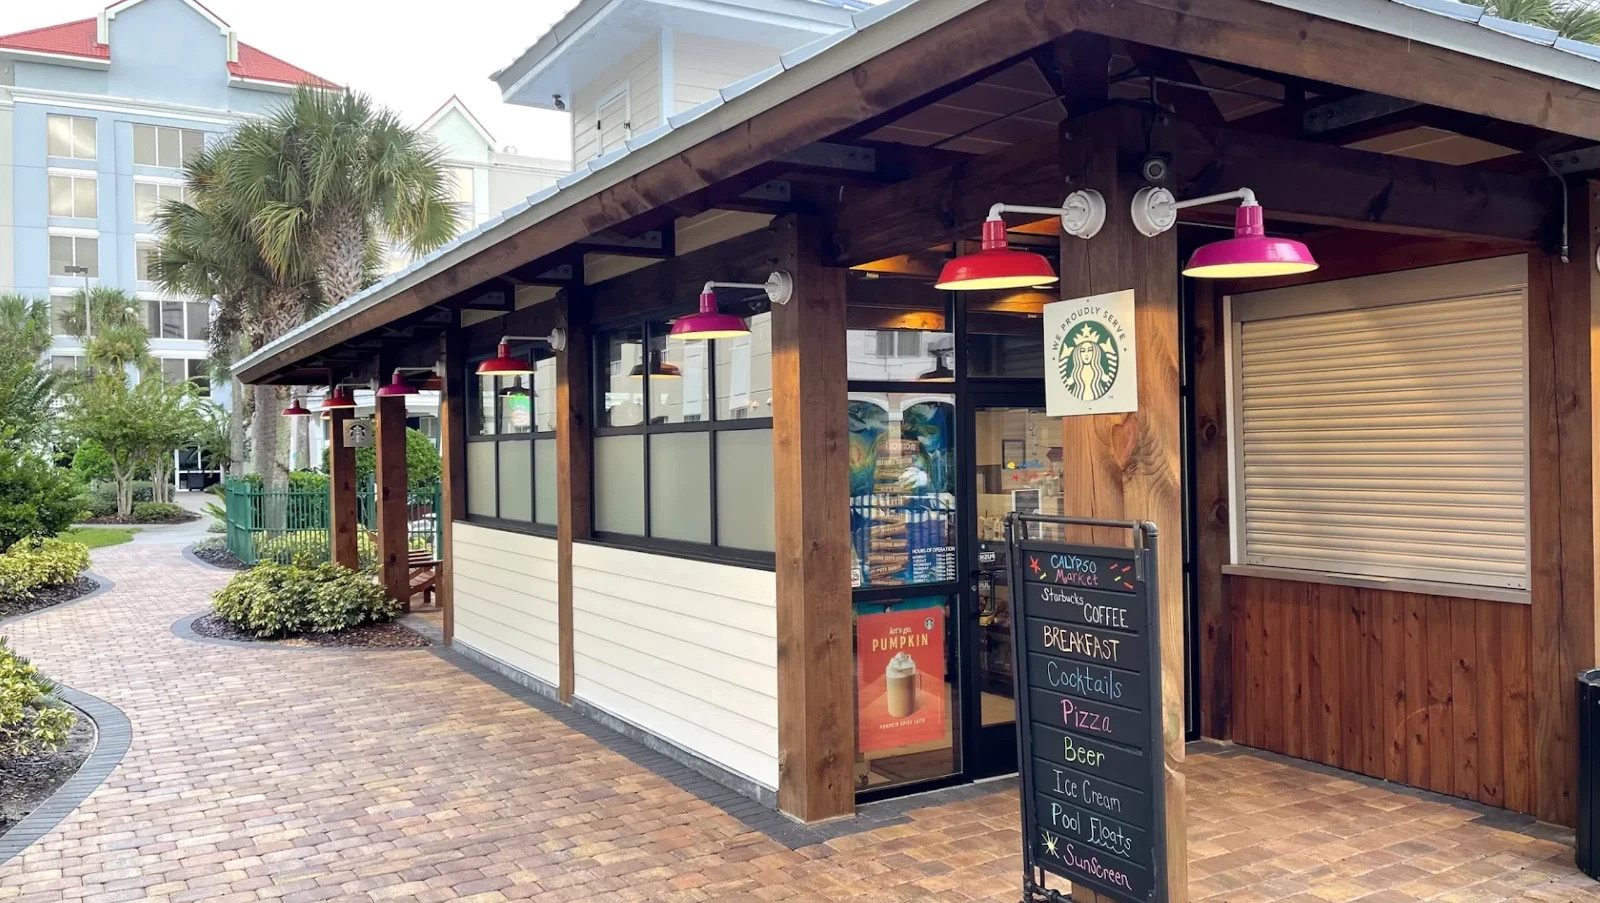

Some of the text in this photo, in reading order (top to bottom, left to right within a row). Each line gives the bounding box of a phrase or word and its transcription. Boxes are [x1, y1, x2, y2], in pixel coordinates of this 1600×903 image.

[1052, 306, 1126, 351] WE PROUDLY SERVE
[1050, 554, 1097, 574] CALYPSO
[1055, 569, 1099, 586] Market
[1041, 587, 1129, 628] Starbucks COFFEE
[872, 633, 929, 652] PUMPKIN
[889, 627, 903, 635] let's
[1043, 625, 1120, 662] BREAKFAST
[1047, 661, 1123, 699] Cocktails
[879, 721, 899, 730] PUMPKIN
[1060, 698, 1112, 733] Pizza
[1064, 736, 1105, 767] Beer
[1053, 768, 1121, 813] Ice Cream
[1051, 802, 1132, 851] Pool Floats
